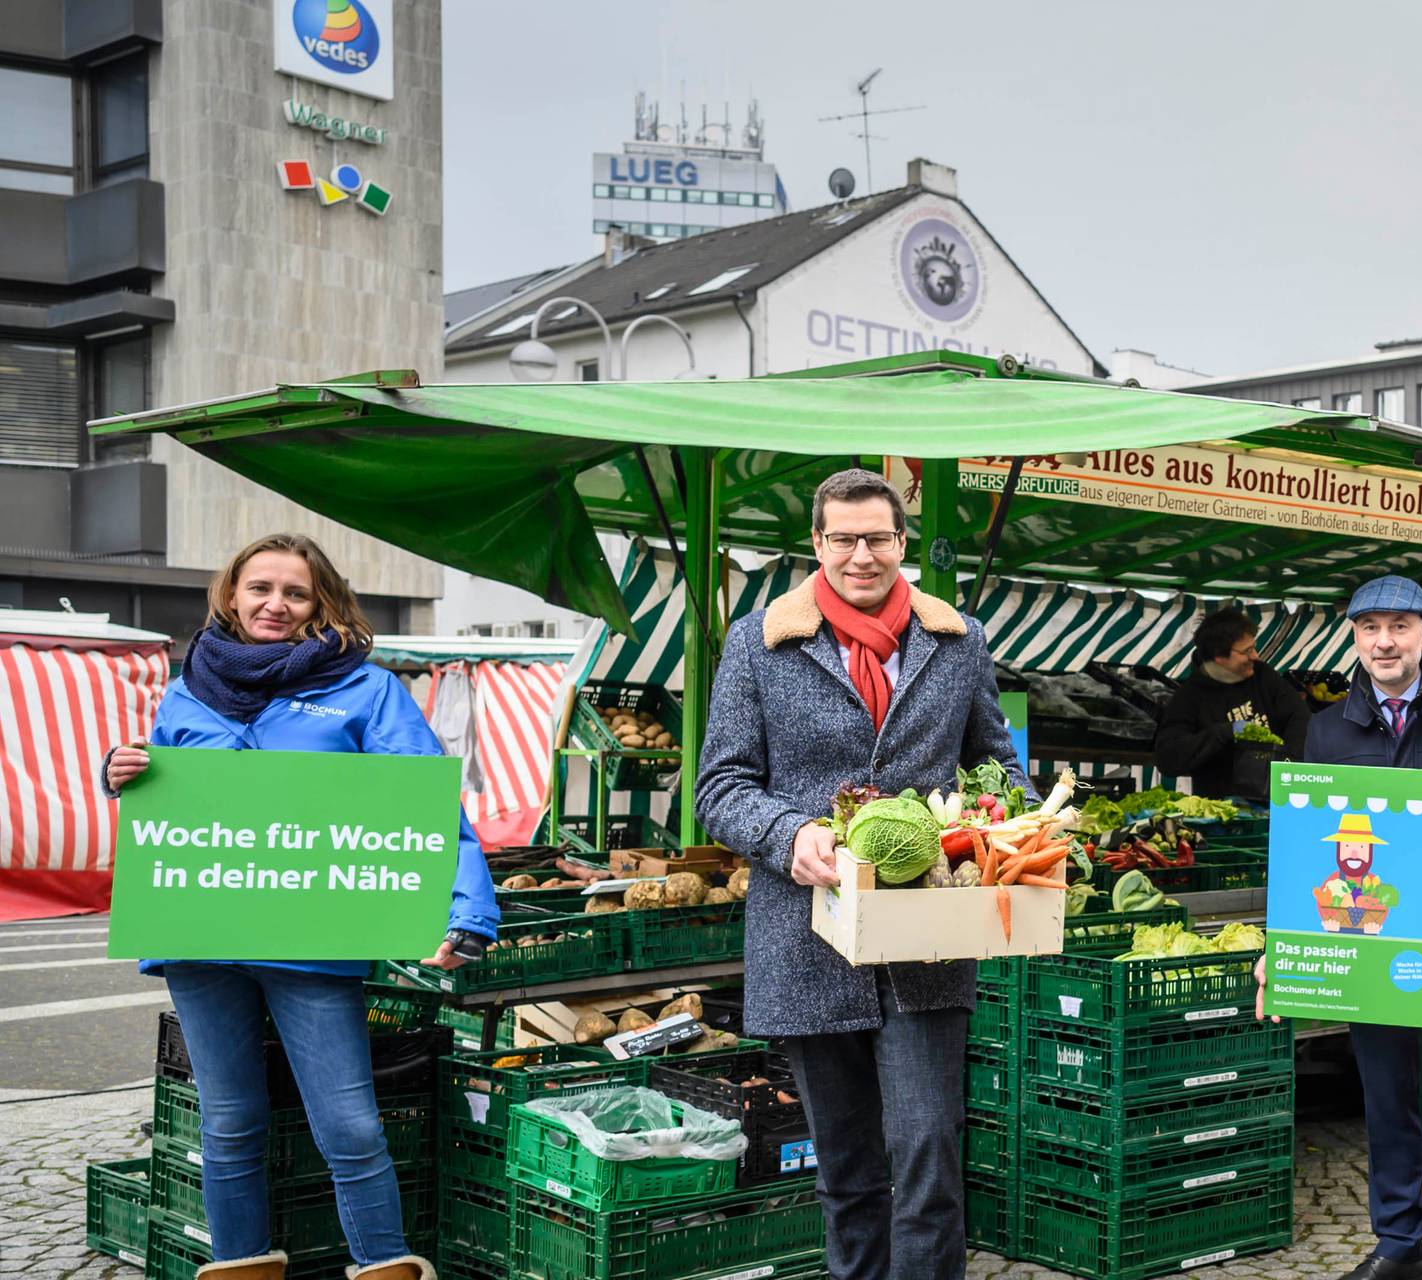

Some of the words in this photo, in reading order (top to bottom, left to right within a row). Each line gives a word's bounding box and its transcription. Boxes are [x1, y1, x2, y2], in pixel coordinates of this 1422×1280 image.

[303, 35, 368, 68] vedes
[285, 96, 385, 145] Wagner
[610, 157, 698, 186] LUEG
[1165, 457, 1213, 486] aus
[1226, 453, 1371, 508] kontrolliert
[1080, 485, 1103, 501] aus
[1106, 487, 1154, 507] eigener
[1157, 491, 1210, 514] Demeter
[1212, 498, 1267, 521] Gärtnerei
[1278, 511, 1298, 524] von
[1352, 520, 1370, 533] aus
[1371, 520, 1389, 536] der
[304, 702, 346, 716] BOCHUM
[1293, 774, 1333, 784] BOCHUM
[132, 820, 256, 848] Woche
[266, 823, 320, 849] für
[329, 825, 445, 852] Woche
[153, 861, 187, 888] in
[198, 862, 318, 890] deiner
[328, 865, 421, 891] Nähe
[1275, 941, 1300, 955] Das
[1303, 945, 1357, 959] passiert
[1275, 958, 1295, 971] dir
[1297, 962, 1321, 973] nur
[1323, 961, 1351, 975] hier
[1273, 984, 1316, 995] Bochumer
[1317, 987, 1342, 998] Markt
